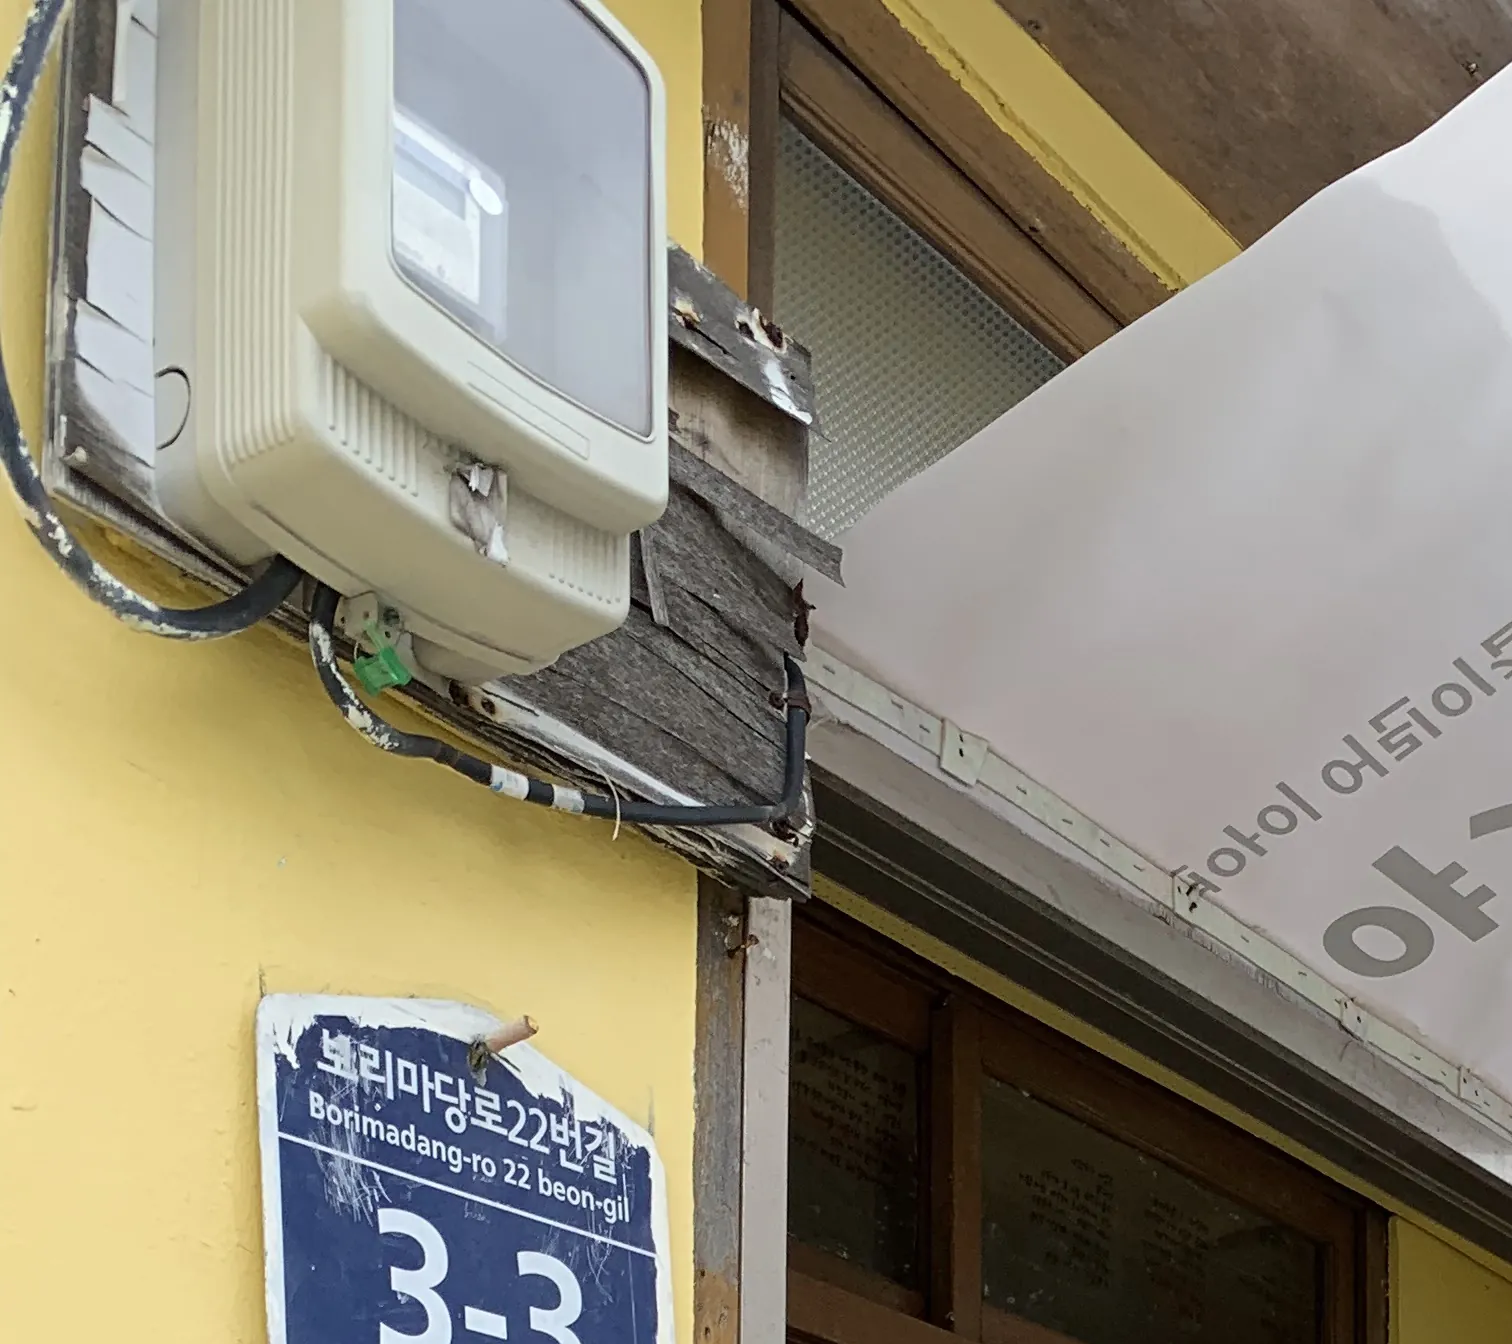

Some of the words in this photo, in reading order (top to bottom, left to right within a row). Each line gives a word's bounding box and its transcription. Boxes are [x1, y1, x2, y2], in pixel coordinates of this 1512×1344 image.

[309, 1090, 497, 1178] Borimadang-ro
[503, 1159, 531, 1191] 22
[538, 1169, 630, 1223] beon-gil
[317, 1029, 617, 1185] 보리마당로22번길
